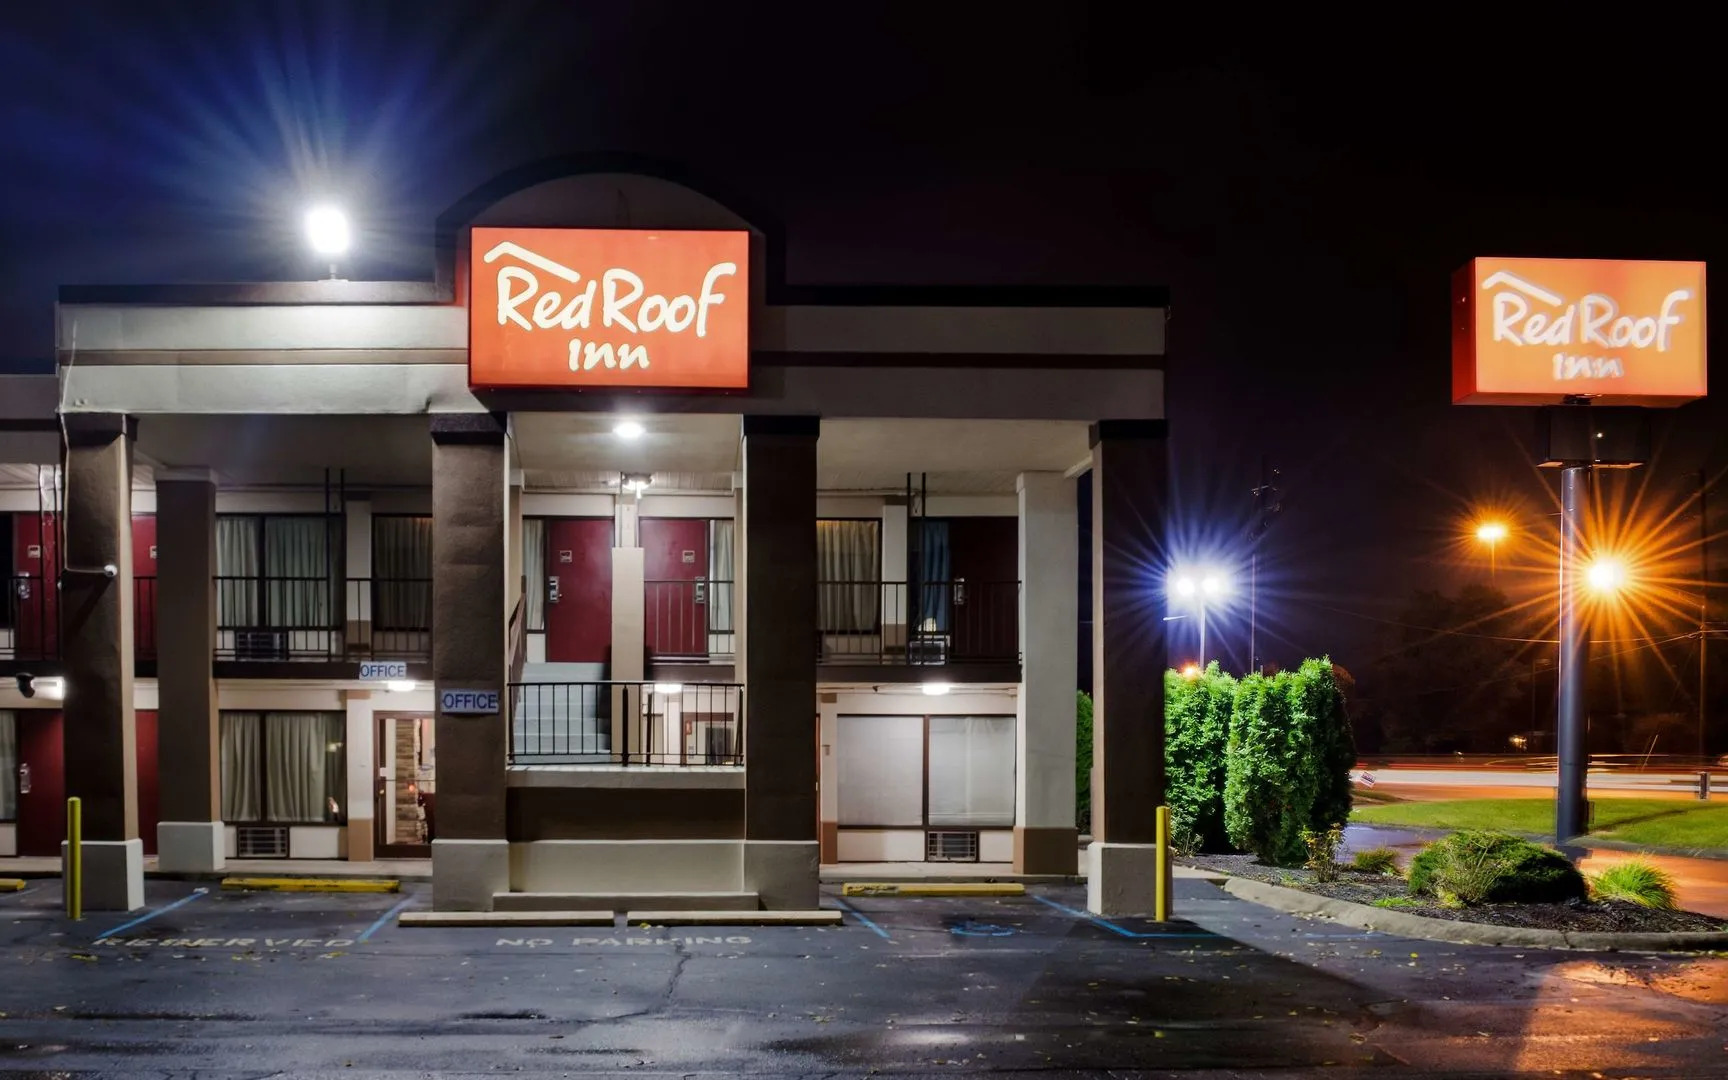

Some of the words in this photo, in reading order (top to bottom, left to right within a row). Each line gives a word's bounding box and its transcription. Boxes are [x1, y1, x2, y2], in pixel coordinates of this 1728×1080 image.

[497, 265, 597, 332] Red
[602, 262, 737, 338] Roof
[1493, 292, 1577, 347] Red
[1580, 289, 1691, 353] Roof
[568, 338, 650, 372] Inn
[360, 664, 406, 678] OFFICE
[443, 693, 498, 710] OFFICE
[495, 937, 554, 947] NO
[572, 936, 753, 947] PARKING
